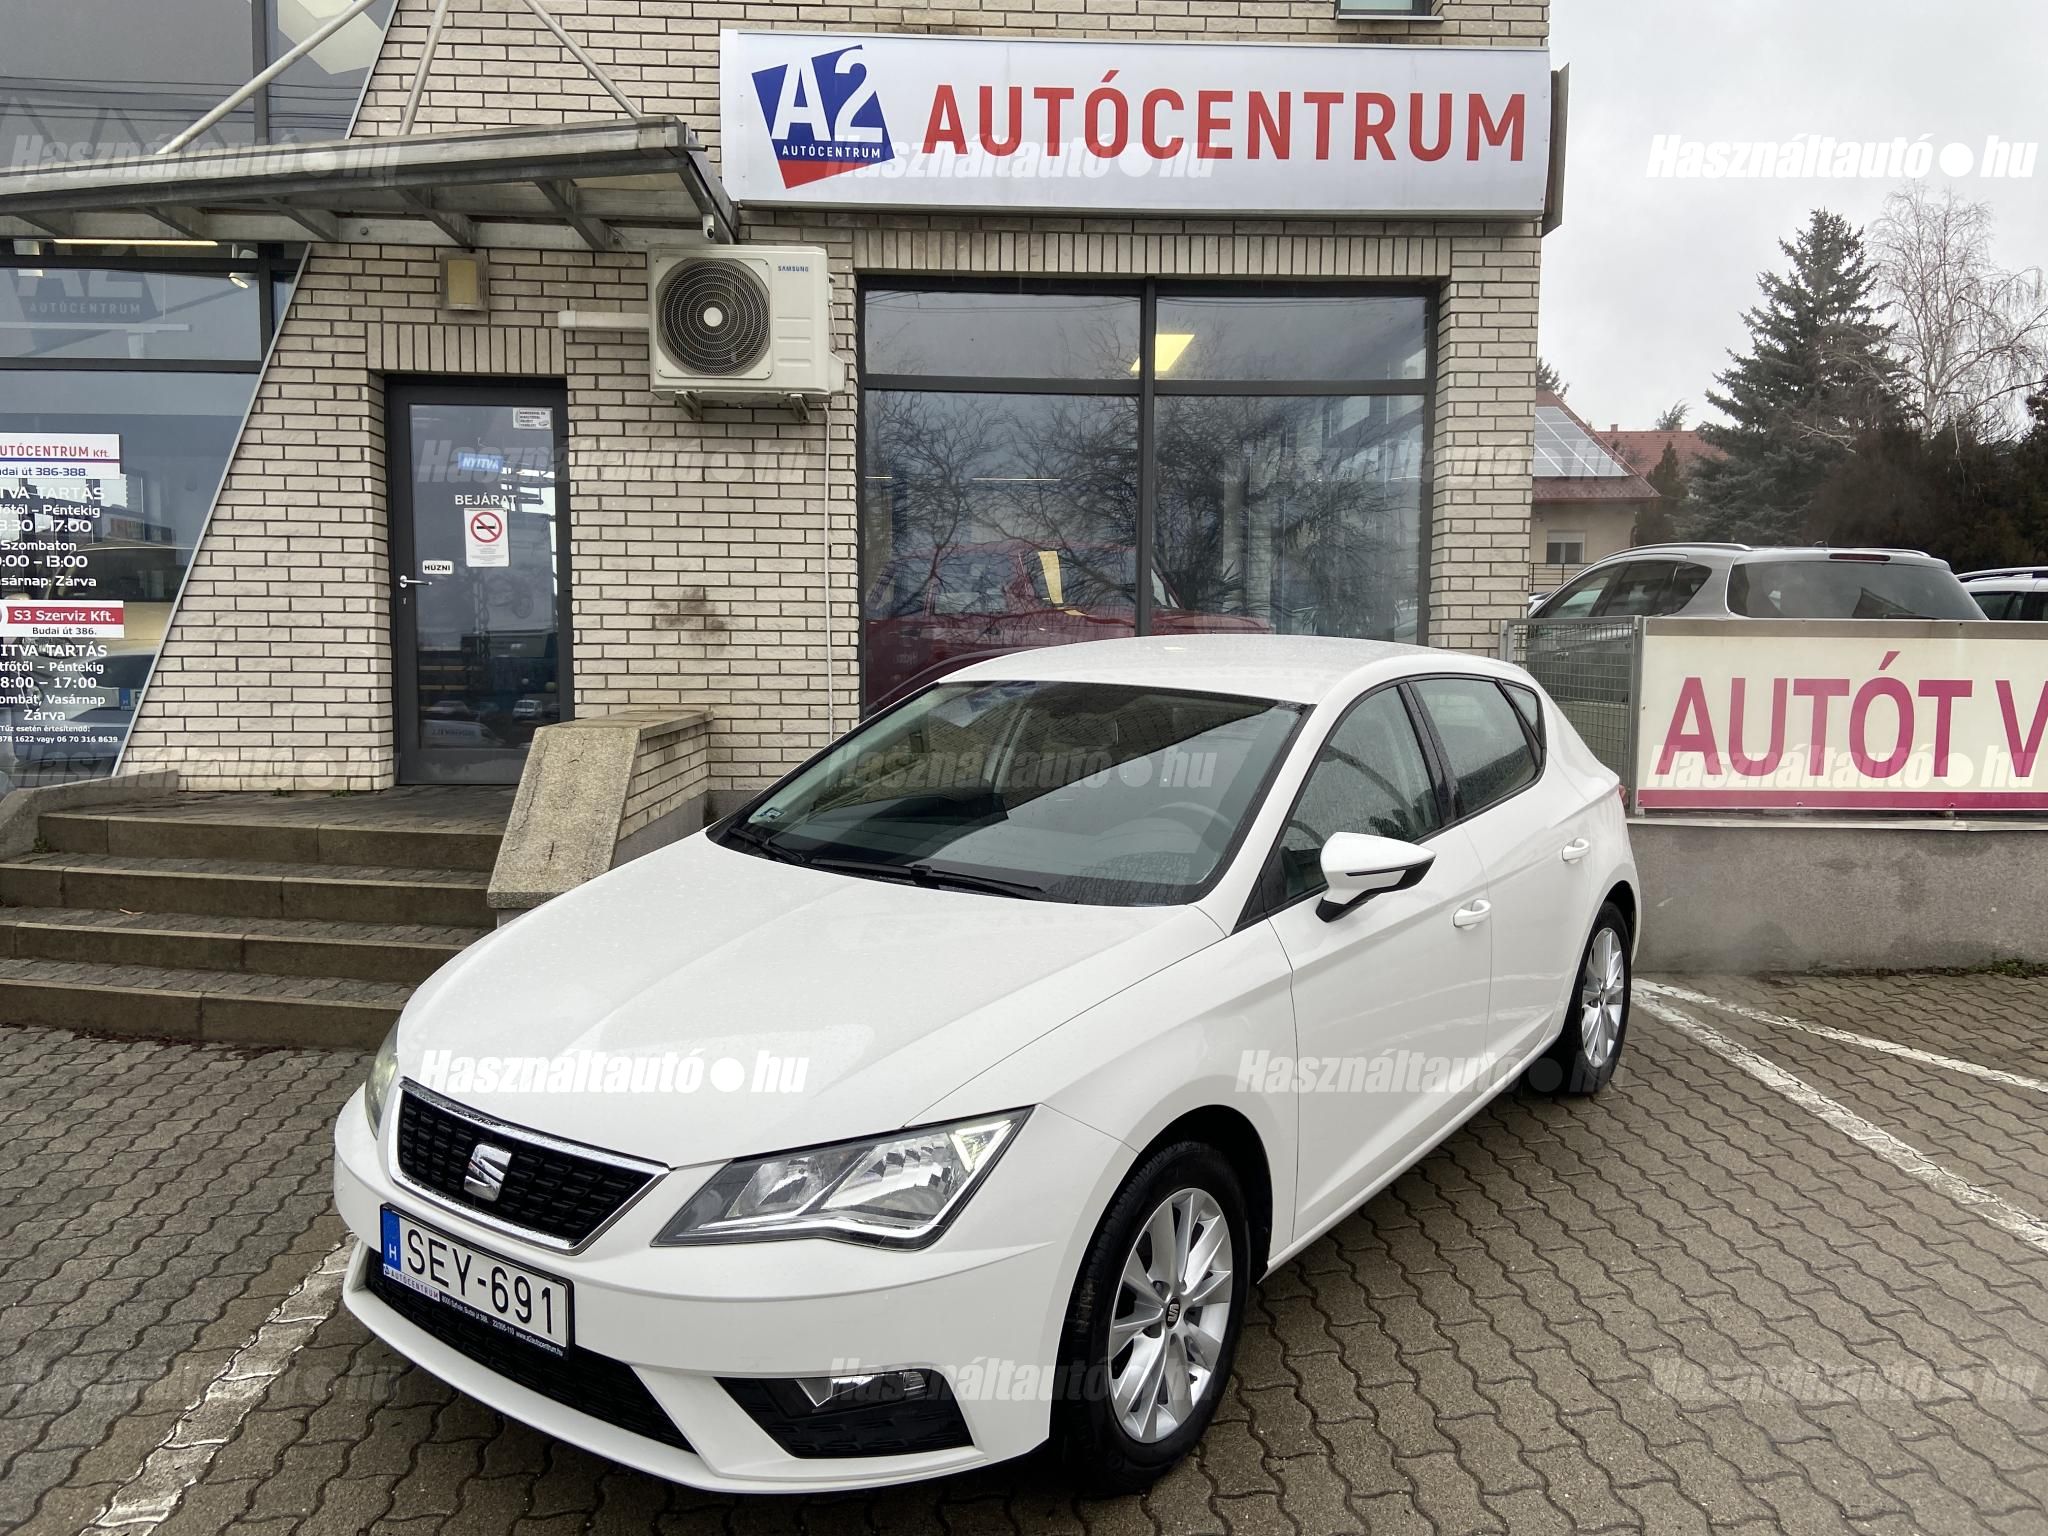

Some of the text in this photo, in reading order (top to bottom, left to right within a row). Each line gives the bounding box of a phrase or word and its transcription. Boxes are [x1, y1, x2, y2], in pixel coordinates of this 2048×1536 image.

[771, 49, 883, 143] A2
[922, 70, 1526, 163] AUTÓCENTRUM
[782, 144, 881, 158] AUTÓCENTRUM
[778, 265, 809, 273] SAMSUNG
[29, 301, 141, 314] AUTÓCENTRUM
[93, 449, 110, 458] Kft.
[462, 457, 499, 470] NYITVA
[0, 467, 18, 475] dai
[37, 484, 105, 500] TARTÁS
[455, 492, 517, 505] BEJÁRAT
[43, 504, 100, 518] Péntekig
[50, 520, 92, 532] 17:00
[1, 540, 77, 551] Szombaton
[47, 555, 88, 568] 13:00
[424, 563, 451, 571] HÚZNI
[0, 575, 97, 588] sárnap: Zárva
[14, 610, 115, 622] S3 Szerviz Kft.
[32, 626, 97, 636] Budai út 386.
[1, 641, 108, 657] ITVA TARTÁS
[49, 661, 104, 674] Péntekig
[1, 677, 35, 688] 8:00
[54, 677, 97, 688] 17:00
[47, 694, 106, 706] Vasárnap
[24, 709, 65, 721] Zárva
[1654, 651, 1973, 779] AUTÓT
[389, 1243, 397, 1262] H
[407, 1228, 552, 1335] SEY-691
